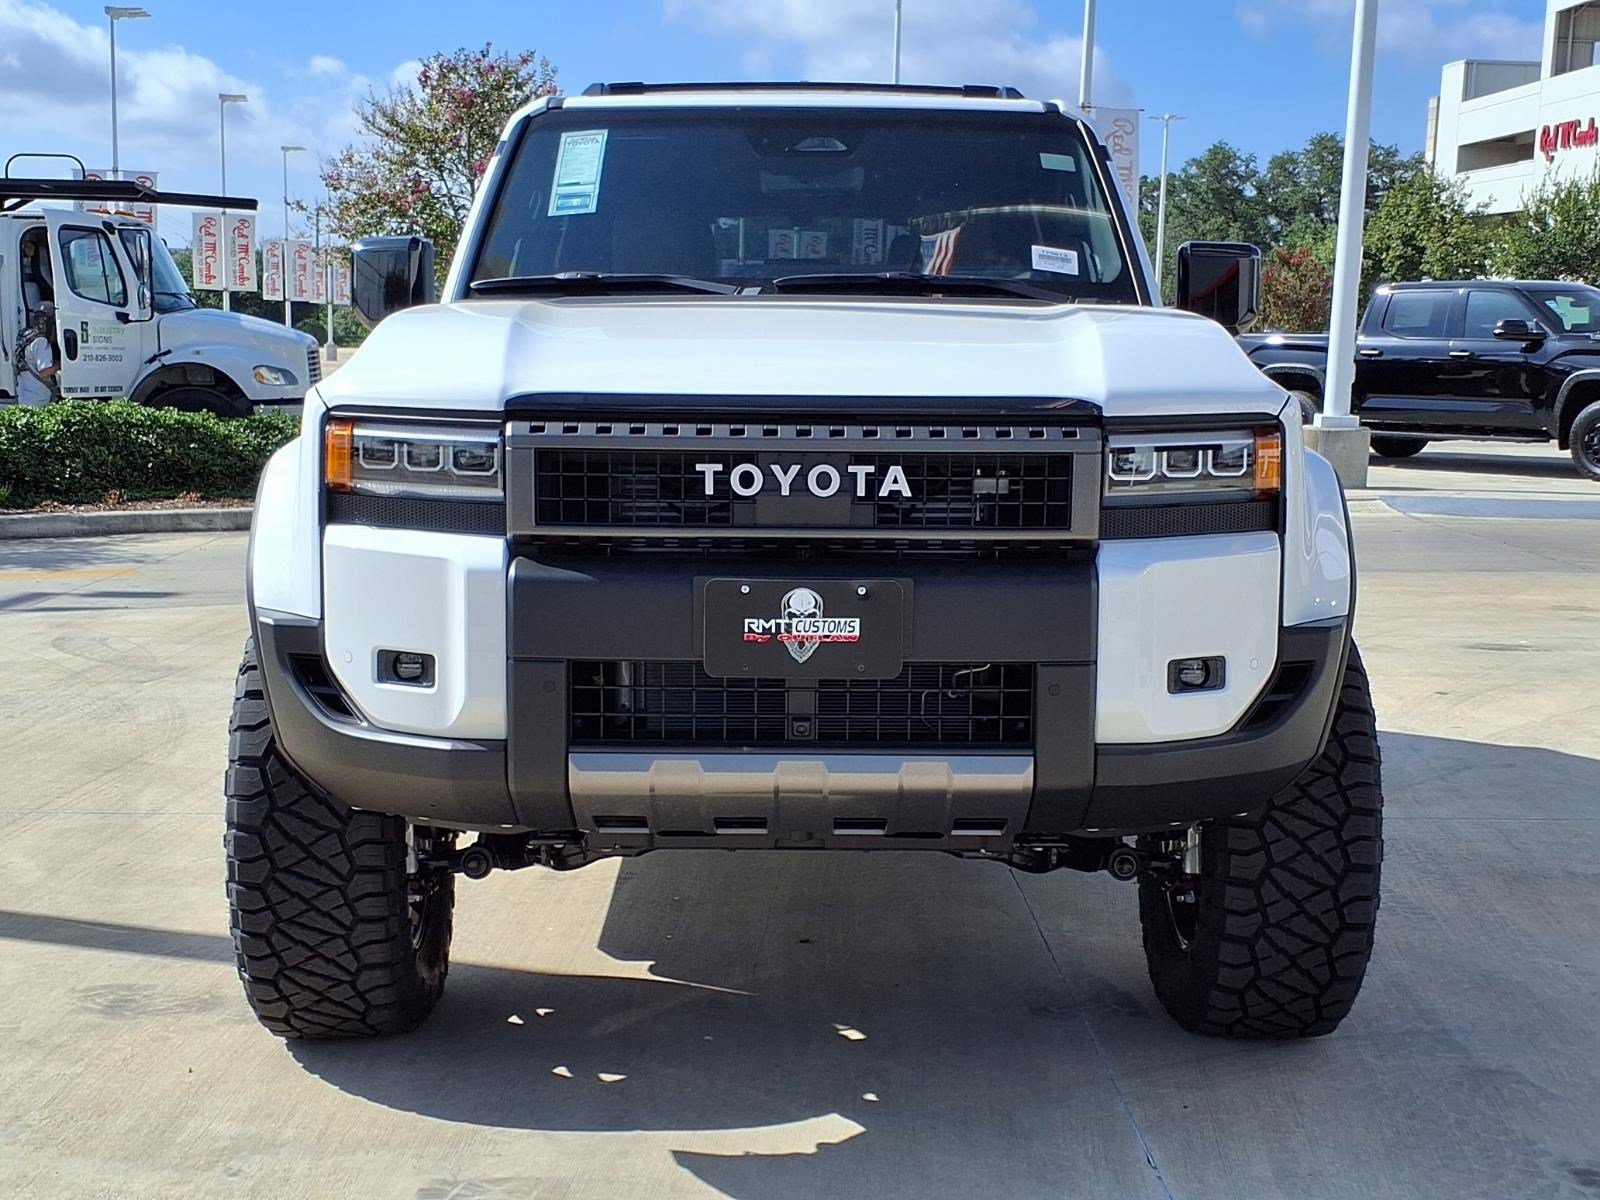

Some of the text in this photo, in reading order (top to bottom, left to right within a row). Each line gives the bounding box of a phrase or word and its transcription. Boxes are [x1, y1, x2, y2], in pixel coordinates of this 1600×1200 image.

[1105, 118, 1135, 156] Red
[1540, 125, 1559, 164] Red
[200, 217, 217, 285] Red McCombs
[233, 219, 251, 287] Red McCombs
[695, 463, 912, 497] TOYOTA
[744, 619, 856, 633] RMT CUSTOMS
